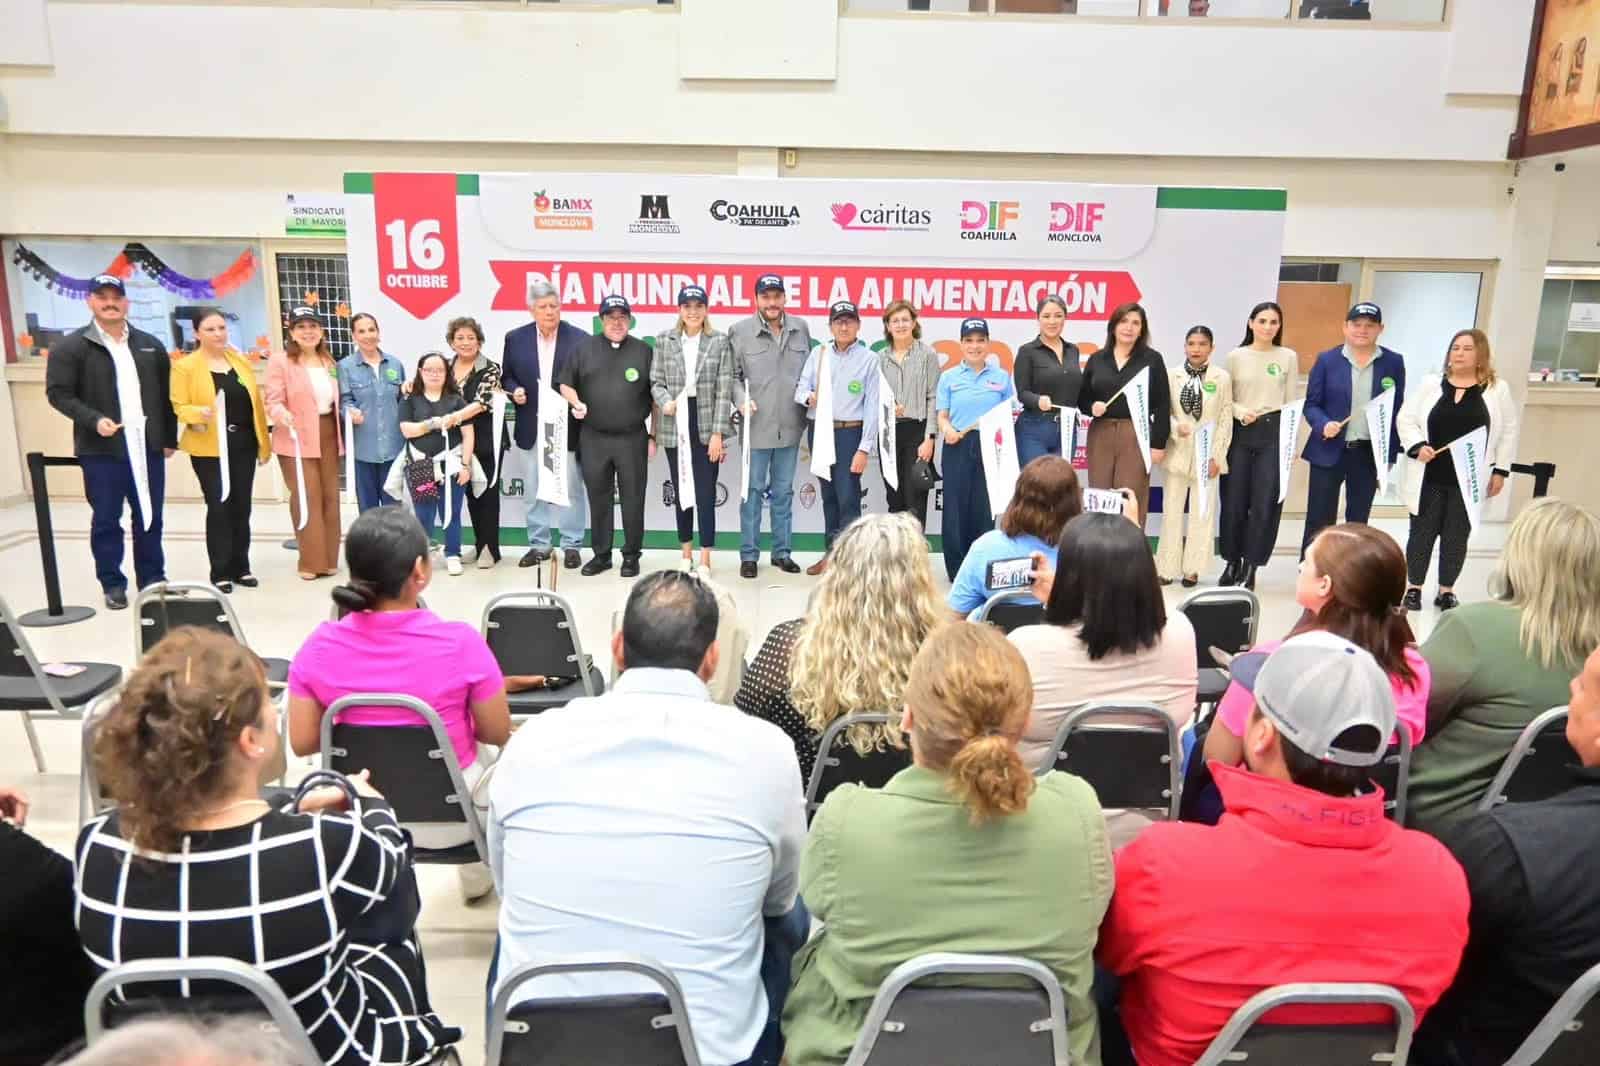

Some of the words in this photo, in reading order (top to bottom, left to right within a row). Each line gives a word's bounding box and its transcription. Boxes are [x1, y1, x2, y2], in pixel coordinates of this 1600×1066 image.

[293, 207, 345, 215] SINDICATU
[552, 198, 592, 211] BAMX
[709, 200, 801, 221] COAHUILA
[860, 203, 931, 225] cáritas
[960, 201, 1019, 230] DIF
[1049, 202, 1105, 232] DIF
[296, 217, 306, 225] DE
[539, 217, 588, 227] MONCLOVA
[755, 218, 786, 226] DELANTE
[628, 223, 681, 233] MONCLOVA
[960, 231, 1017, 241] COAHUILA
[1048, 233, 1102, 243] MONCLOVA
[385, 218, 446, 270] 16
[386, 273, 449, 289] OCTUBRE
[808, 276, 853, 309] LA
[859, 272, 1107, 314] ALIMENTACIÓN
